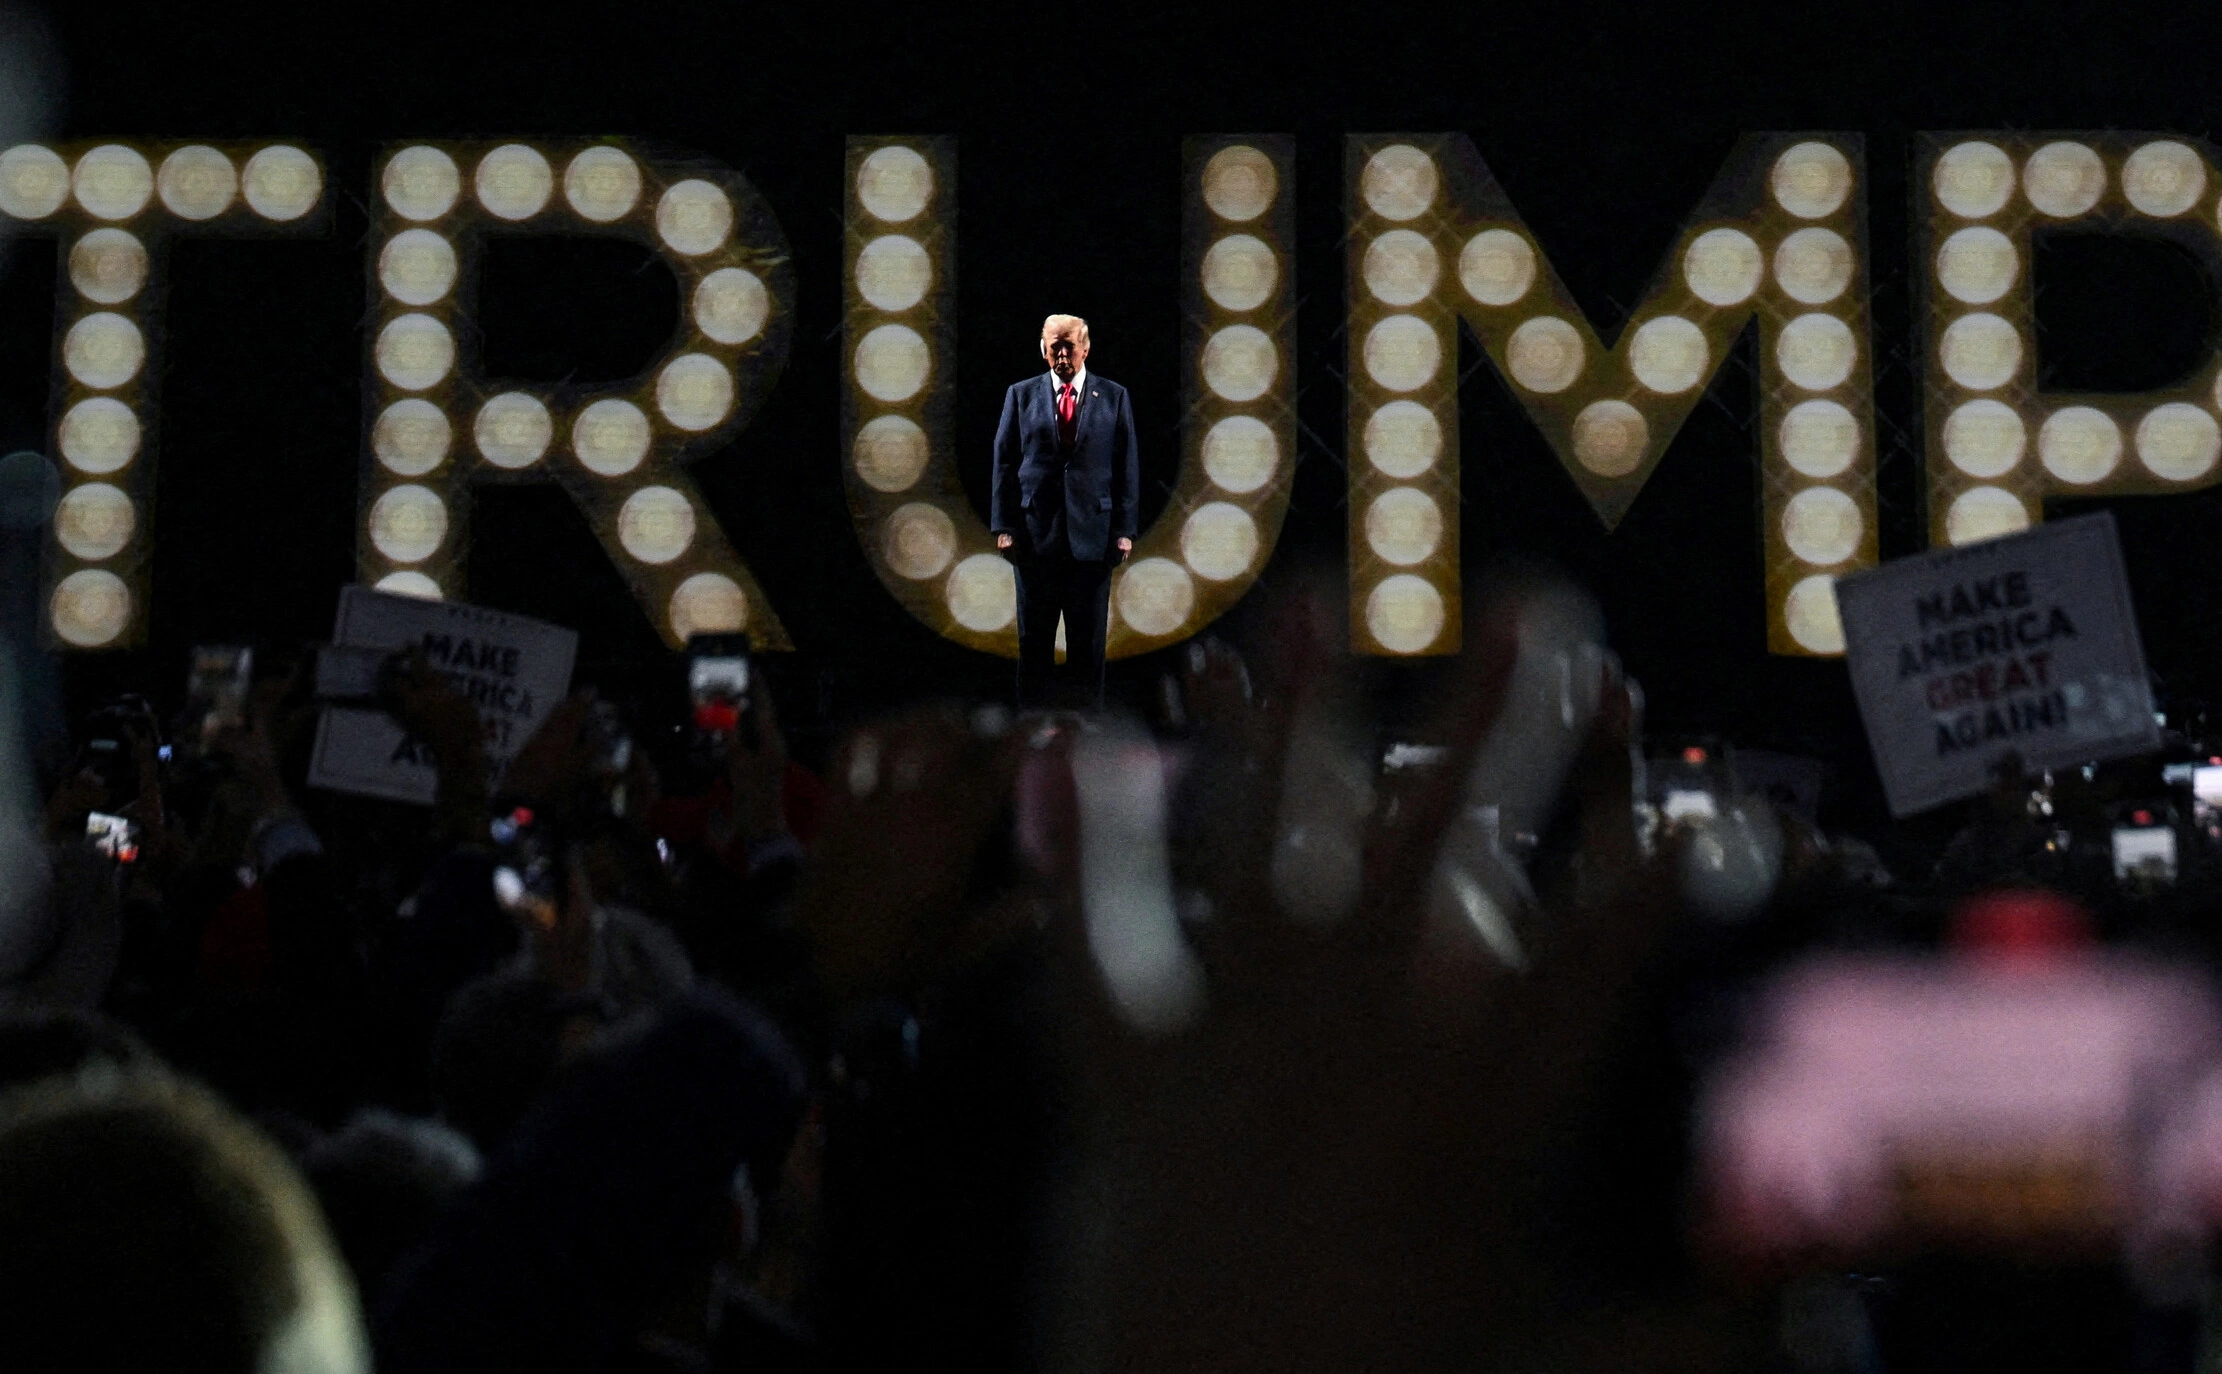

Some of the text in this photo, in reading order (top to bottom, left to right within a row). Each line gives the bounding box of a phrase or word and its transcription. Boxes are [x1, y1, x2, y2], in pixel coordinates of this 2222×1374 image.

[0, 132, 2222, 657] TRUMP
[1914, 571, 2033, 627] MAKE
[421, 631, 521, 677] MAKE
[1897, 606, 2078, 680] AMERICA
[1925, 652, 2054, 711] GREAT
[1935, 690, 2069, 757] AGAIN!
